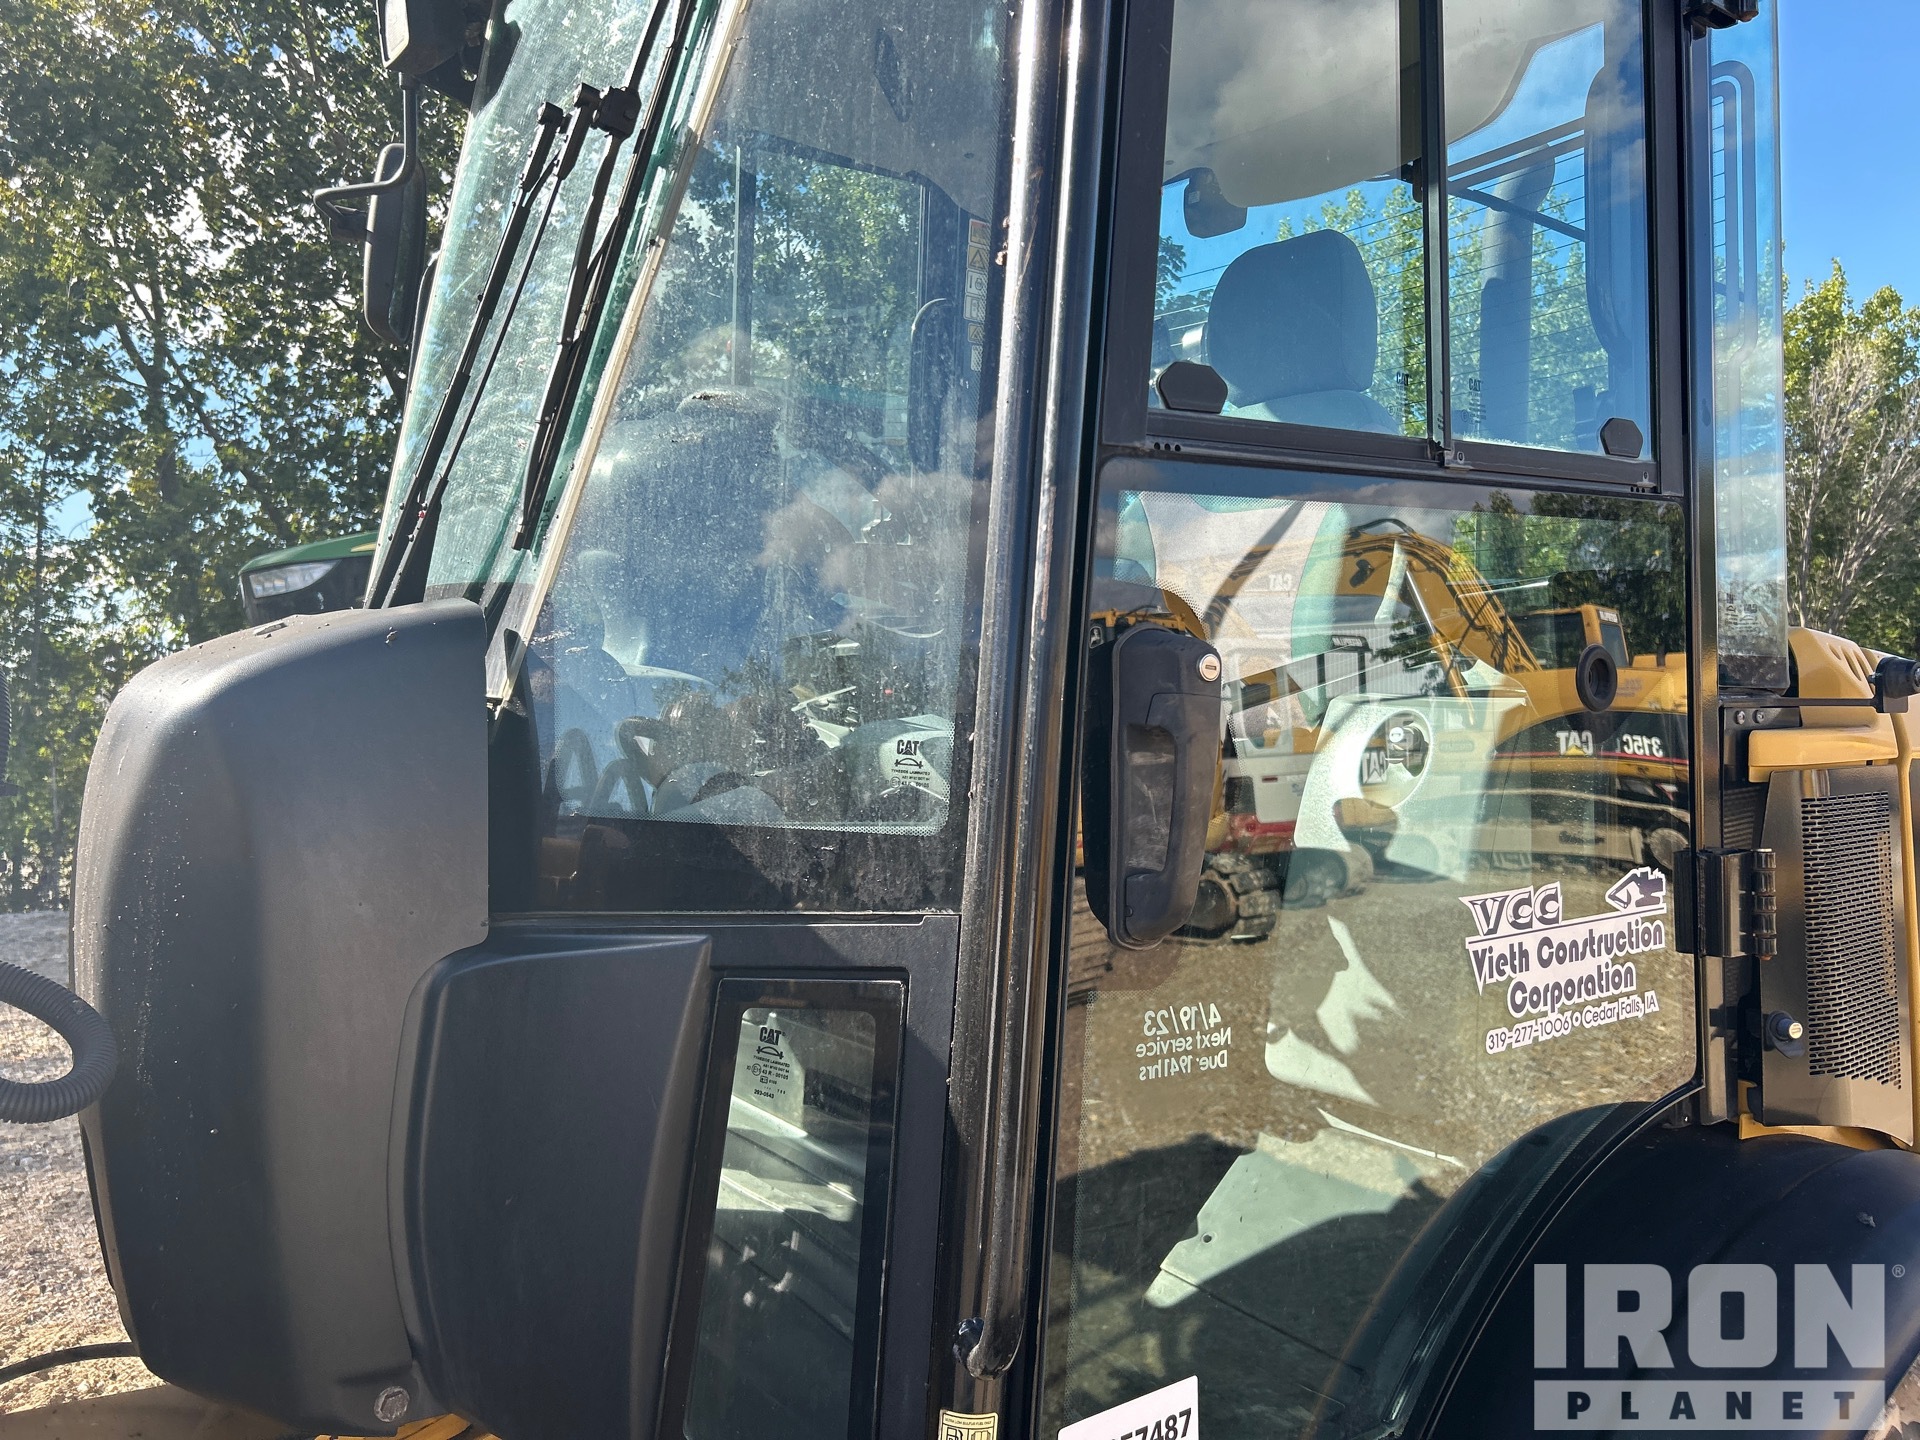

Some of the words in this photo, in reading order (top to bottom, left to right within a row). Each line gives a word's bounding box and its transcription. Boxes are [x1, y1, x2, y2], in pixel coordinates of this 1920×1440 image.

[1468, 378, 1481, 391] CAT
[897, 740, 919, 756] CAT
[1467, 885, 1561, 937] VCC
[1472, 941, 1530, 982] Vieth
[1536, 919, 1663, 969] Construction
[1510, 964, 1635, 1014] Corporation
[759, 1027, 782, 1045] CAT
[1488, 1016, 1571, 1050] 319-277-1006
[1583, 1005, 1616, 1025] Cedar
[1646, 995, 1657, 1010] IA
